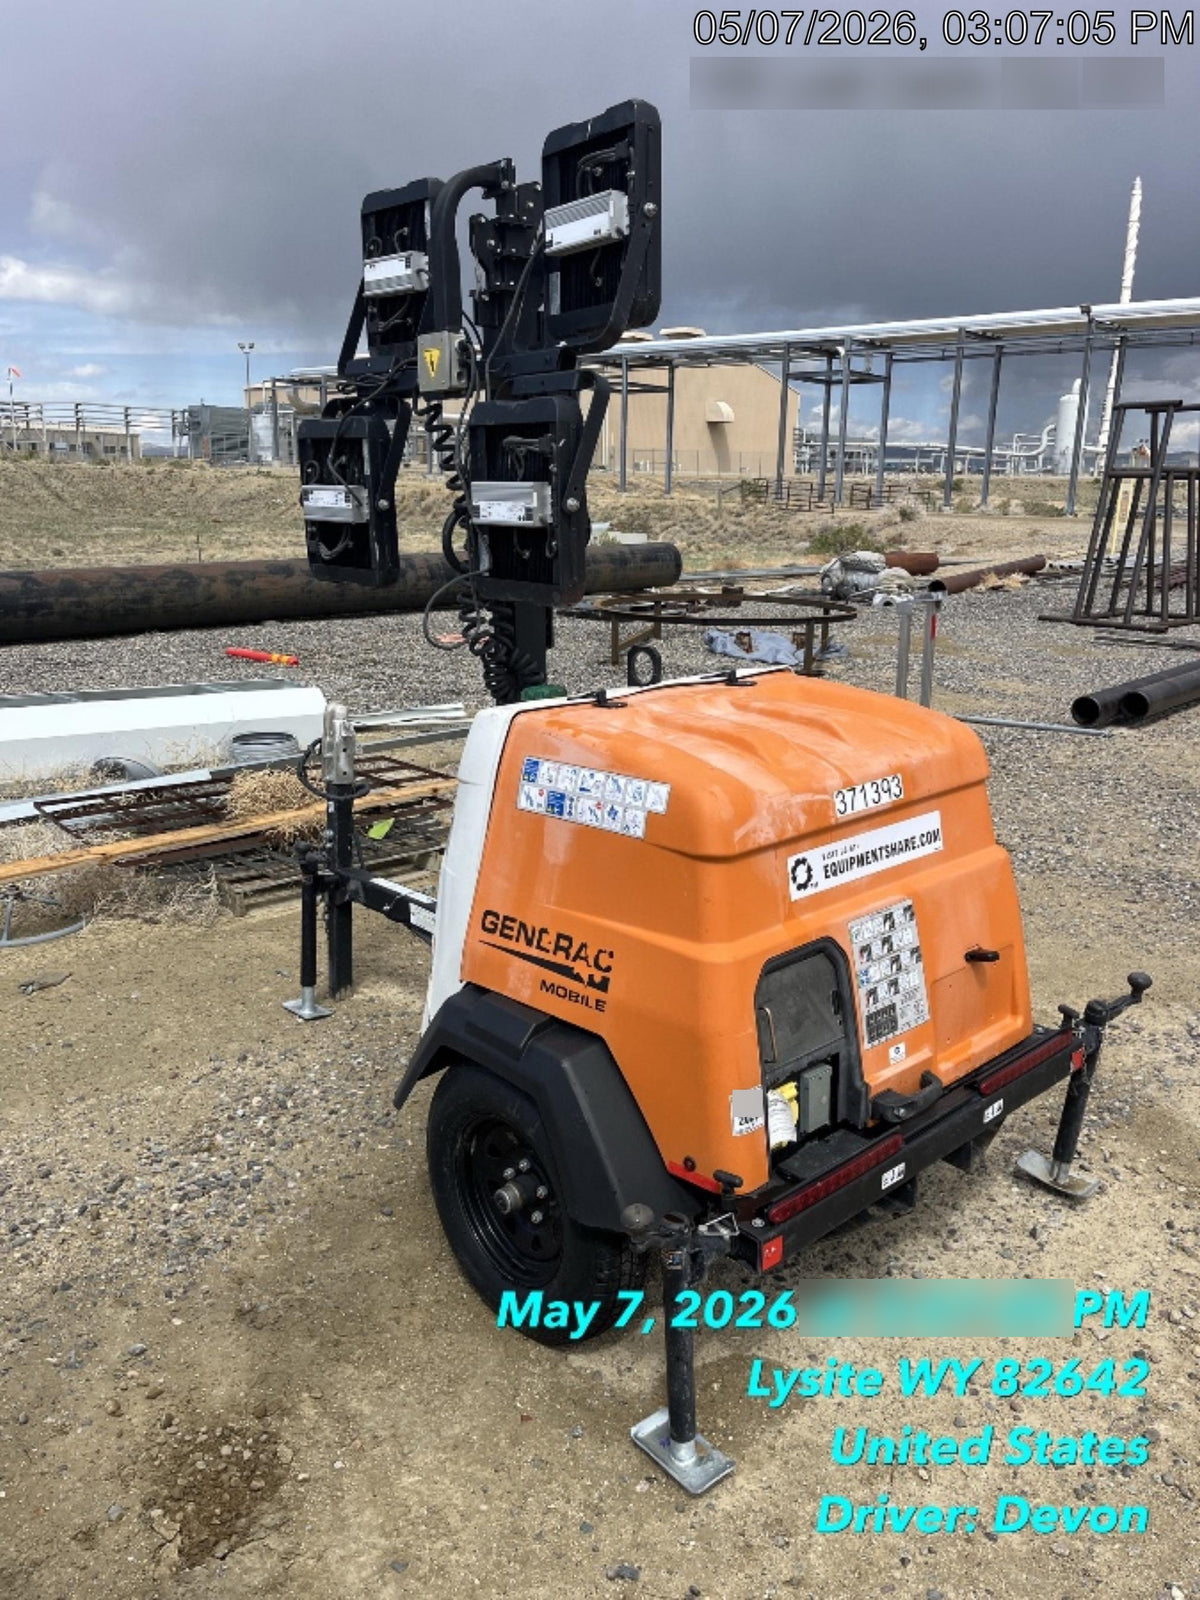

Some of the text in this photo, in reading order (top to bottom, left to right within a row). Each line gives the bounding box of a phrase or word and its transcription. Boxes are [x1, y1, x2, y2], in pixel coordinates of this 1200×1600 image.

[835, 775, 903, 815] 371393
[823, 828, 941, 879] EQUIPMENTSHARE.COM
[481, 910, 614, 973] GENERAC
[540, 979, 607, 1012] MOBILE
